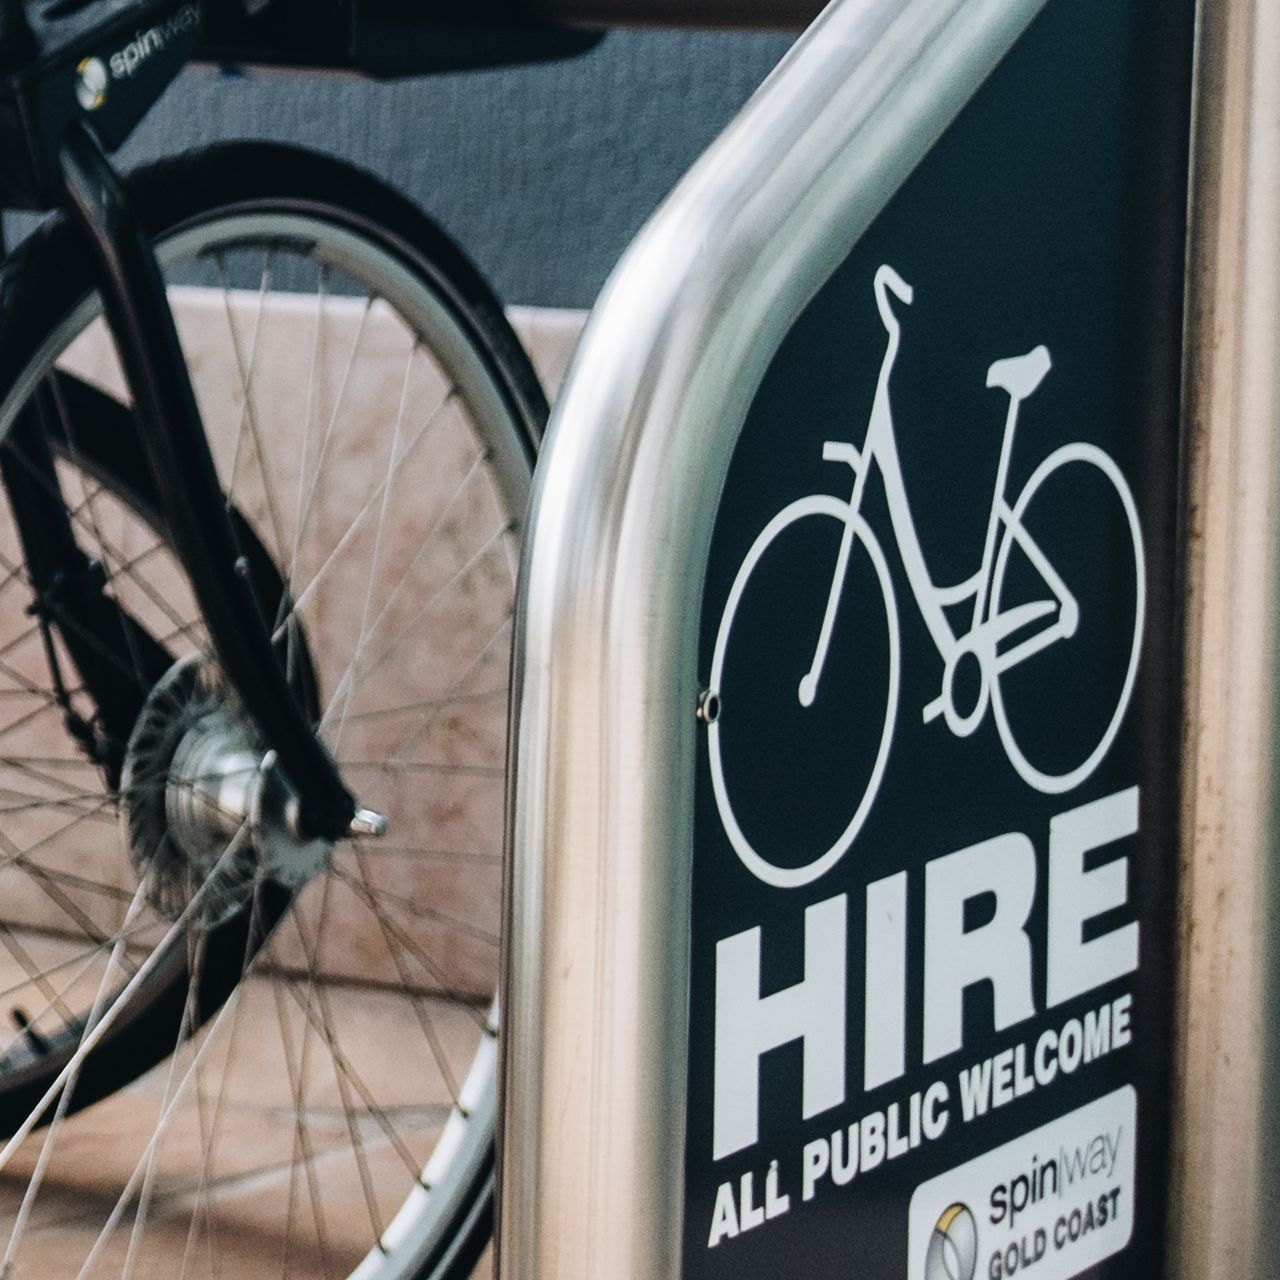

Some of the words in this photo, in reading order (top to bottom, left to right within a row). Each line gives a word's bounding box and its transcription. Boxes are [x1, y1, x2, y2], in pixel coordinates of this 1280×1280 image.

[713, 785, 1139, 1161] HIRE
[707, 1161, 789, 1248] ALL
[802, 1081, 949, 1201] PUBLIC
[959, 994, 1132, 1122] WELCOME
[989, 1227, 1046, 1280] GOLD
[1054, 1184, 1121, 1251] COAST
